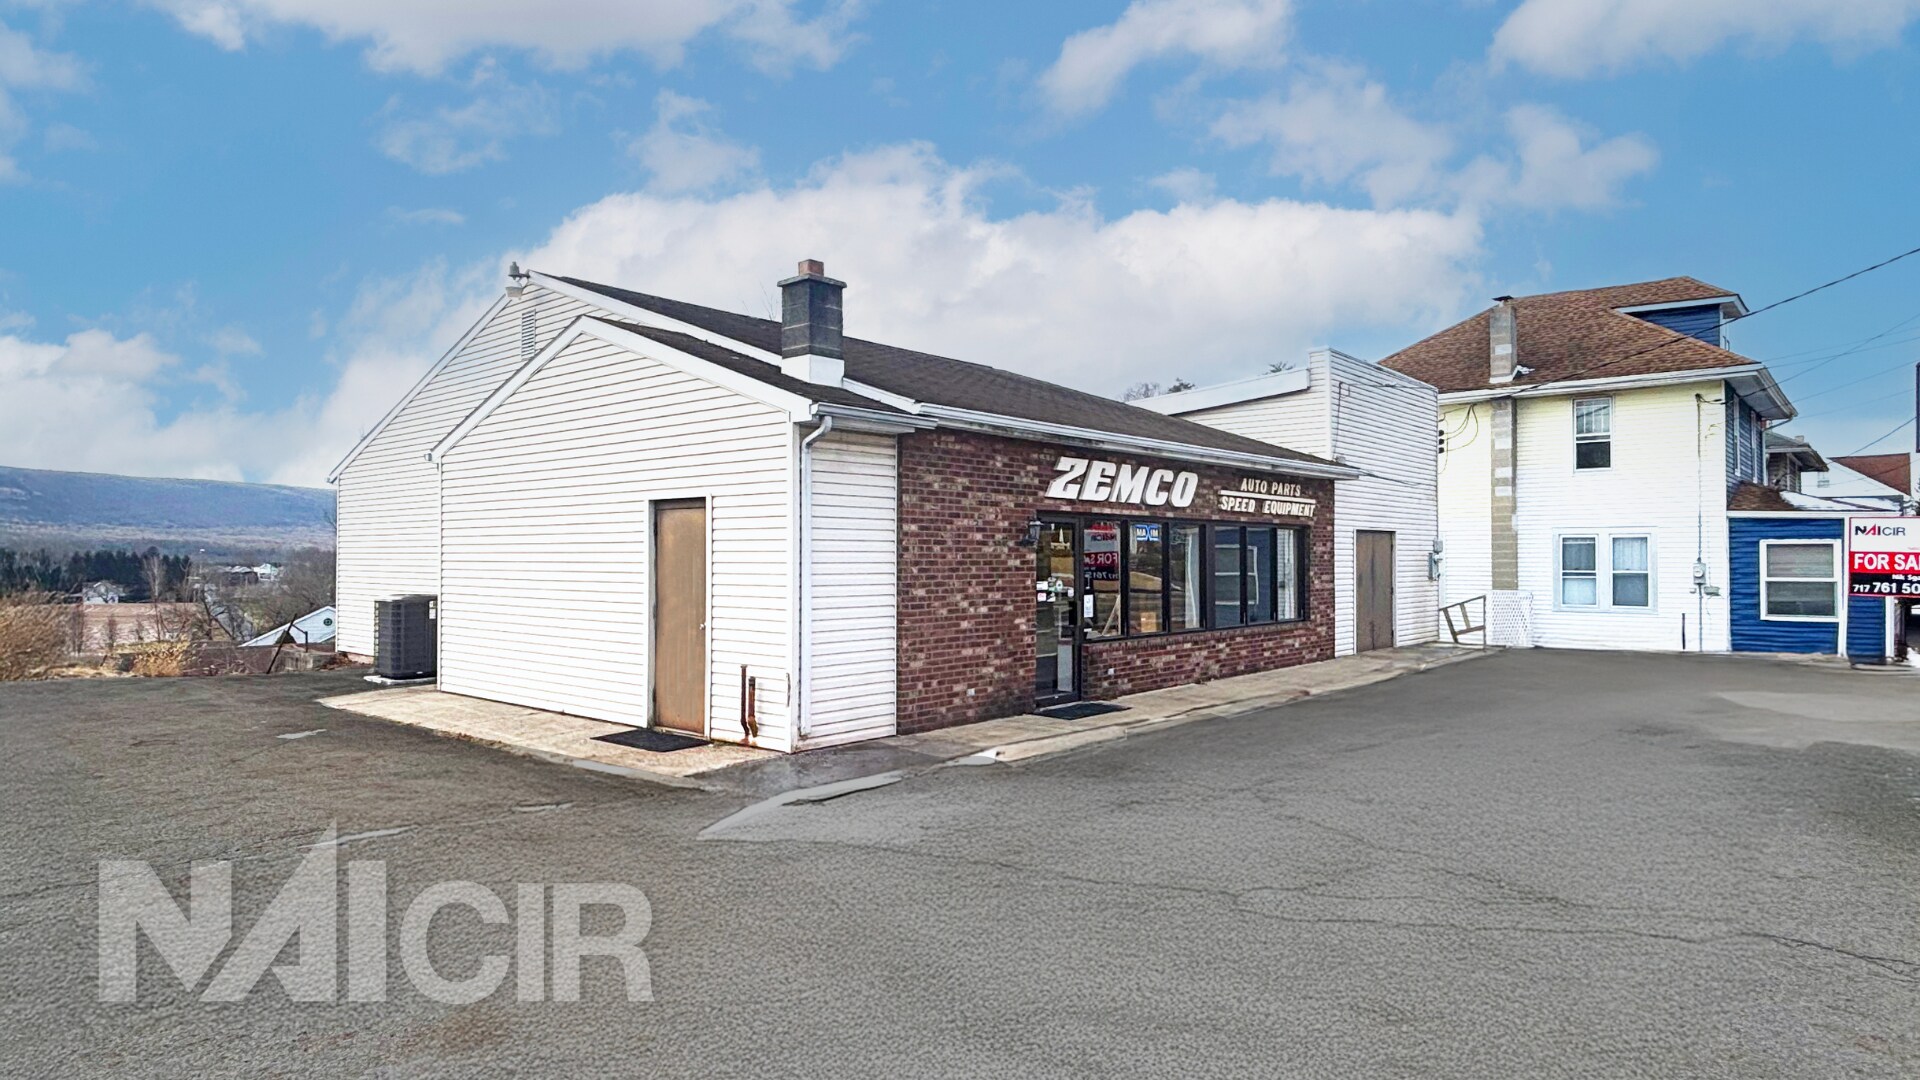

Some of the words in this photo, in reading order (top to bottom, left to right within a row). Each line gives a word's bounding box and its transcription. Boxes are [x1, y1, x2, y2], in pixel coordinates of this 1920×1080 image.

[1045, 456, 1198, 508] ZEMCO
[1241, 478, 1268, 494] AUTO
[1271, 482, 1301, 496] PARTS
[1220, 496, 1256, 512] SPEED
[1262, 500, 1316, 517] EQUIPMENT
[1854, 553, 1890, 570] FOR
[1894, 554, 1920, 571] SA
[1853, 584, 1870, 592] 717
[1873, 582, 1897, 593] 761
